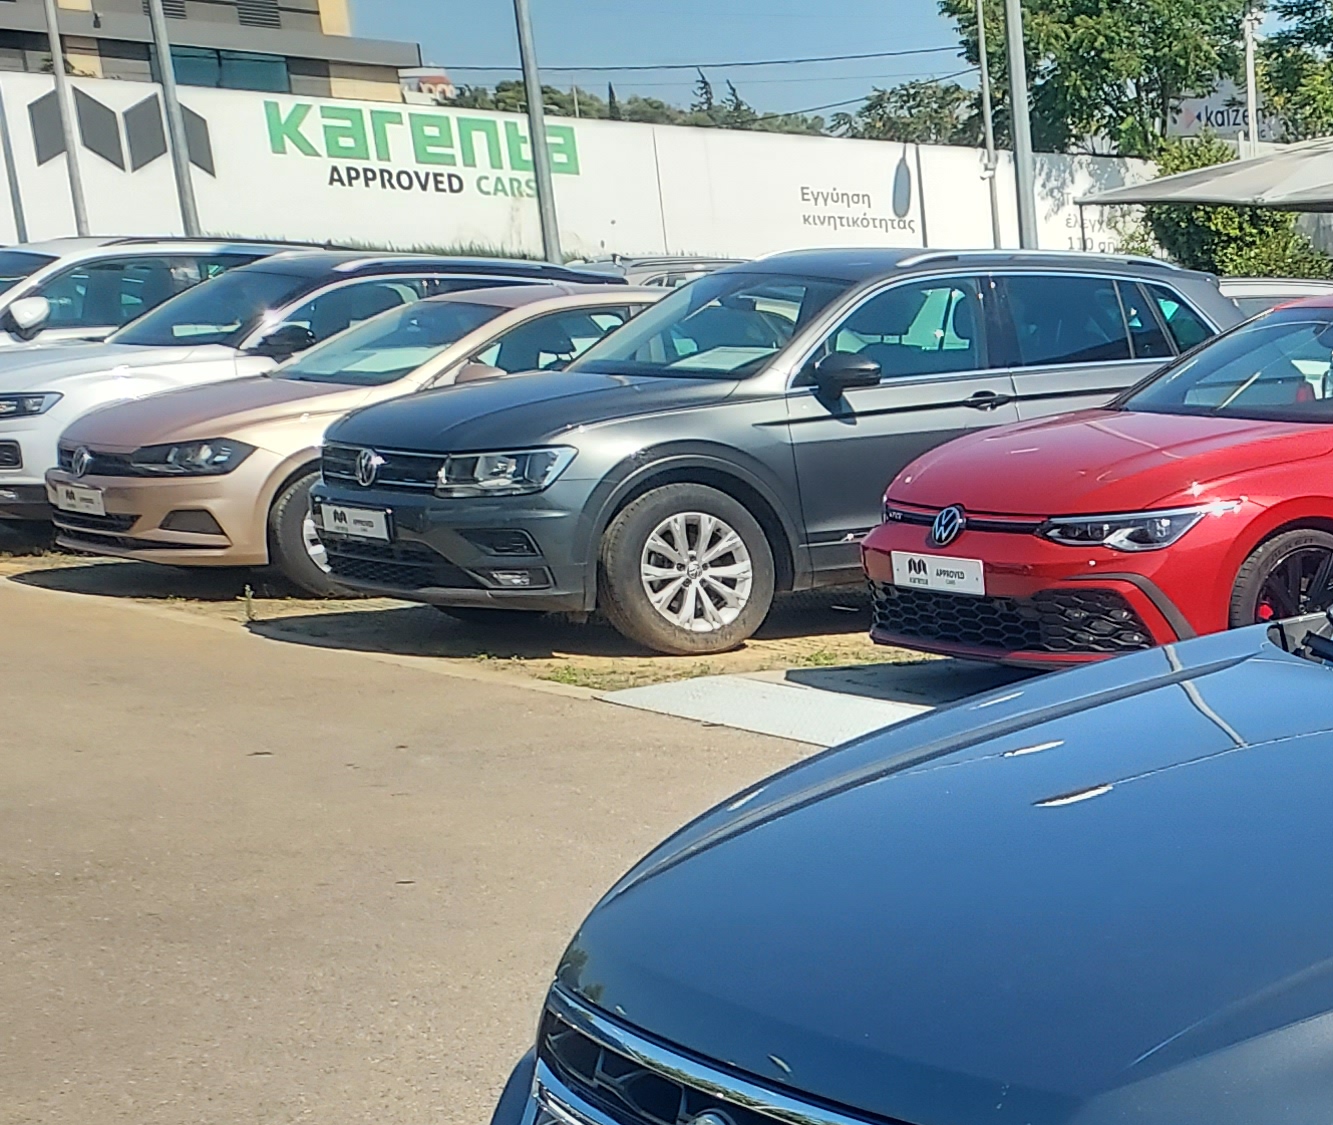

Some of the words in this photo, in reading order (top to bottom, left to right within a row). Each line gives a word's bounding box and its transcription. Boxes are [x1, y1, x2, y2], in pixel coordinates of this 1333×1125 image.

[328, 165, 464, 194] APPROVED
[476, 175, 538, 198] CARS
[800, 186, 871, 208] Εγγύηση
[802, 212, 915, 233] κινητικότητας
